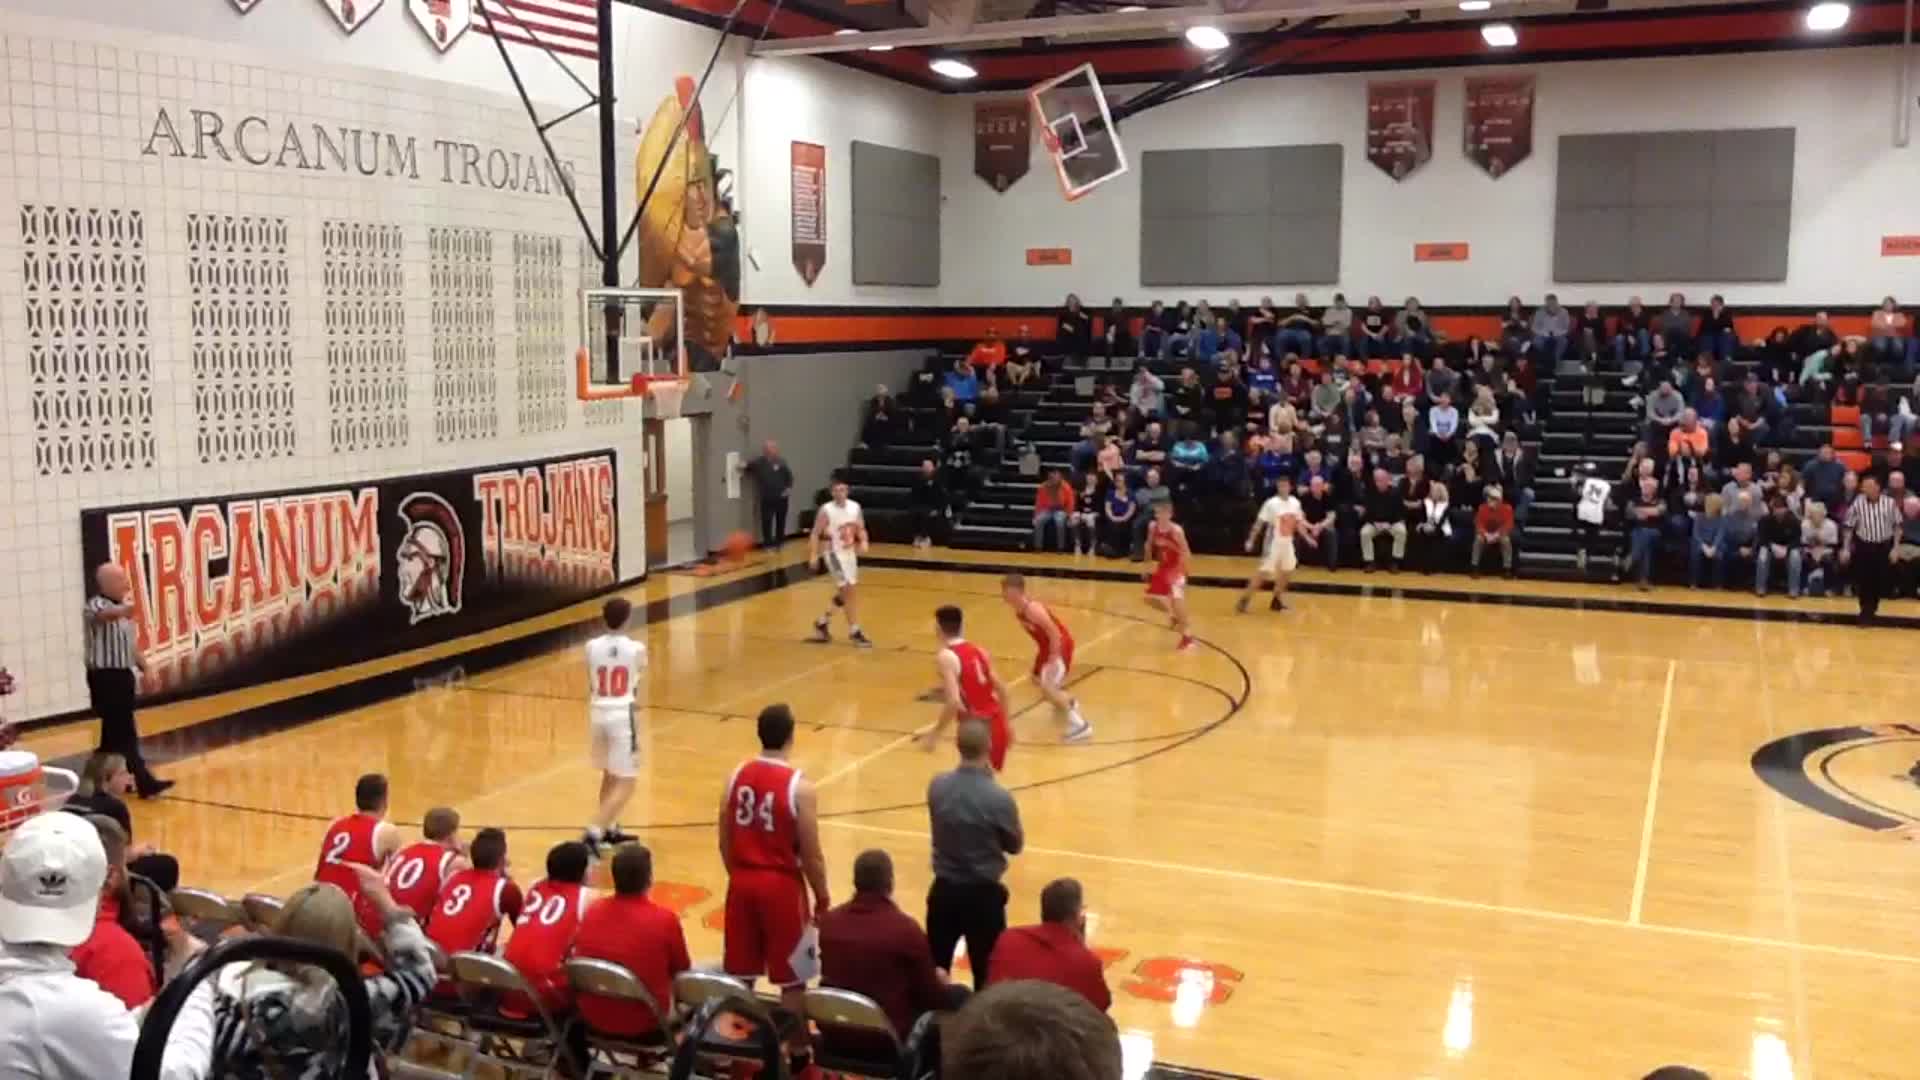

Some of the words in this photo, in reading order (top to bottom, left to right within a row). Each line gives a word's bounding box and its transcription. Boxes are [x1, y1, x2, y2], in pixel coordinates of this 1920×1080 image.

[141, 106, 420, 179] ARCANUM
[434, 139, 576, 197] TROJANS
[108, 487, 380, 660] ARCANUM
[473, 455, 615, 562] TROJANS
[597, 665, 629, 697] 10
[735, 785, 776, 832] 34
[325, 831, 351, 865] 2
[443, 883, 472, 916] 3
[516, 888, 567, 926] 20
